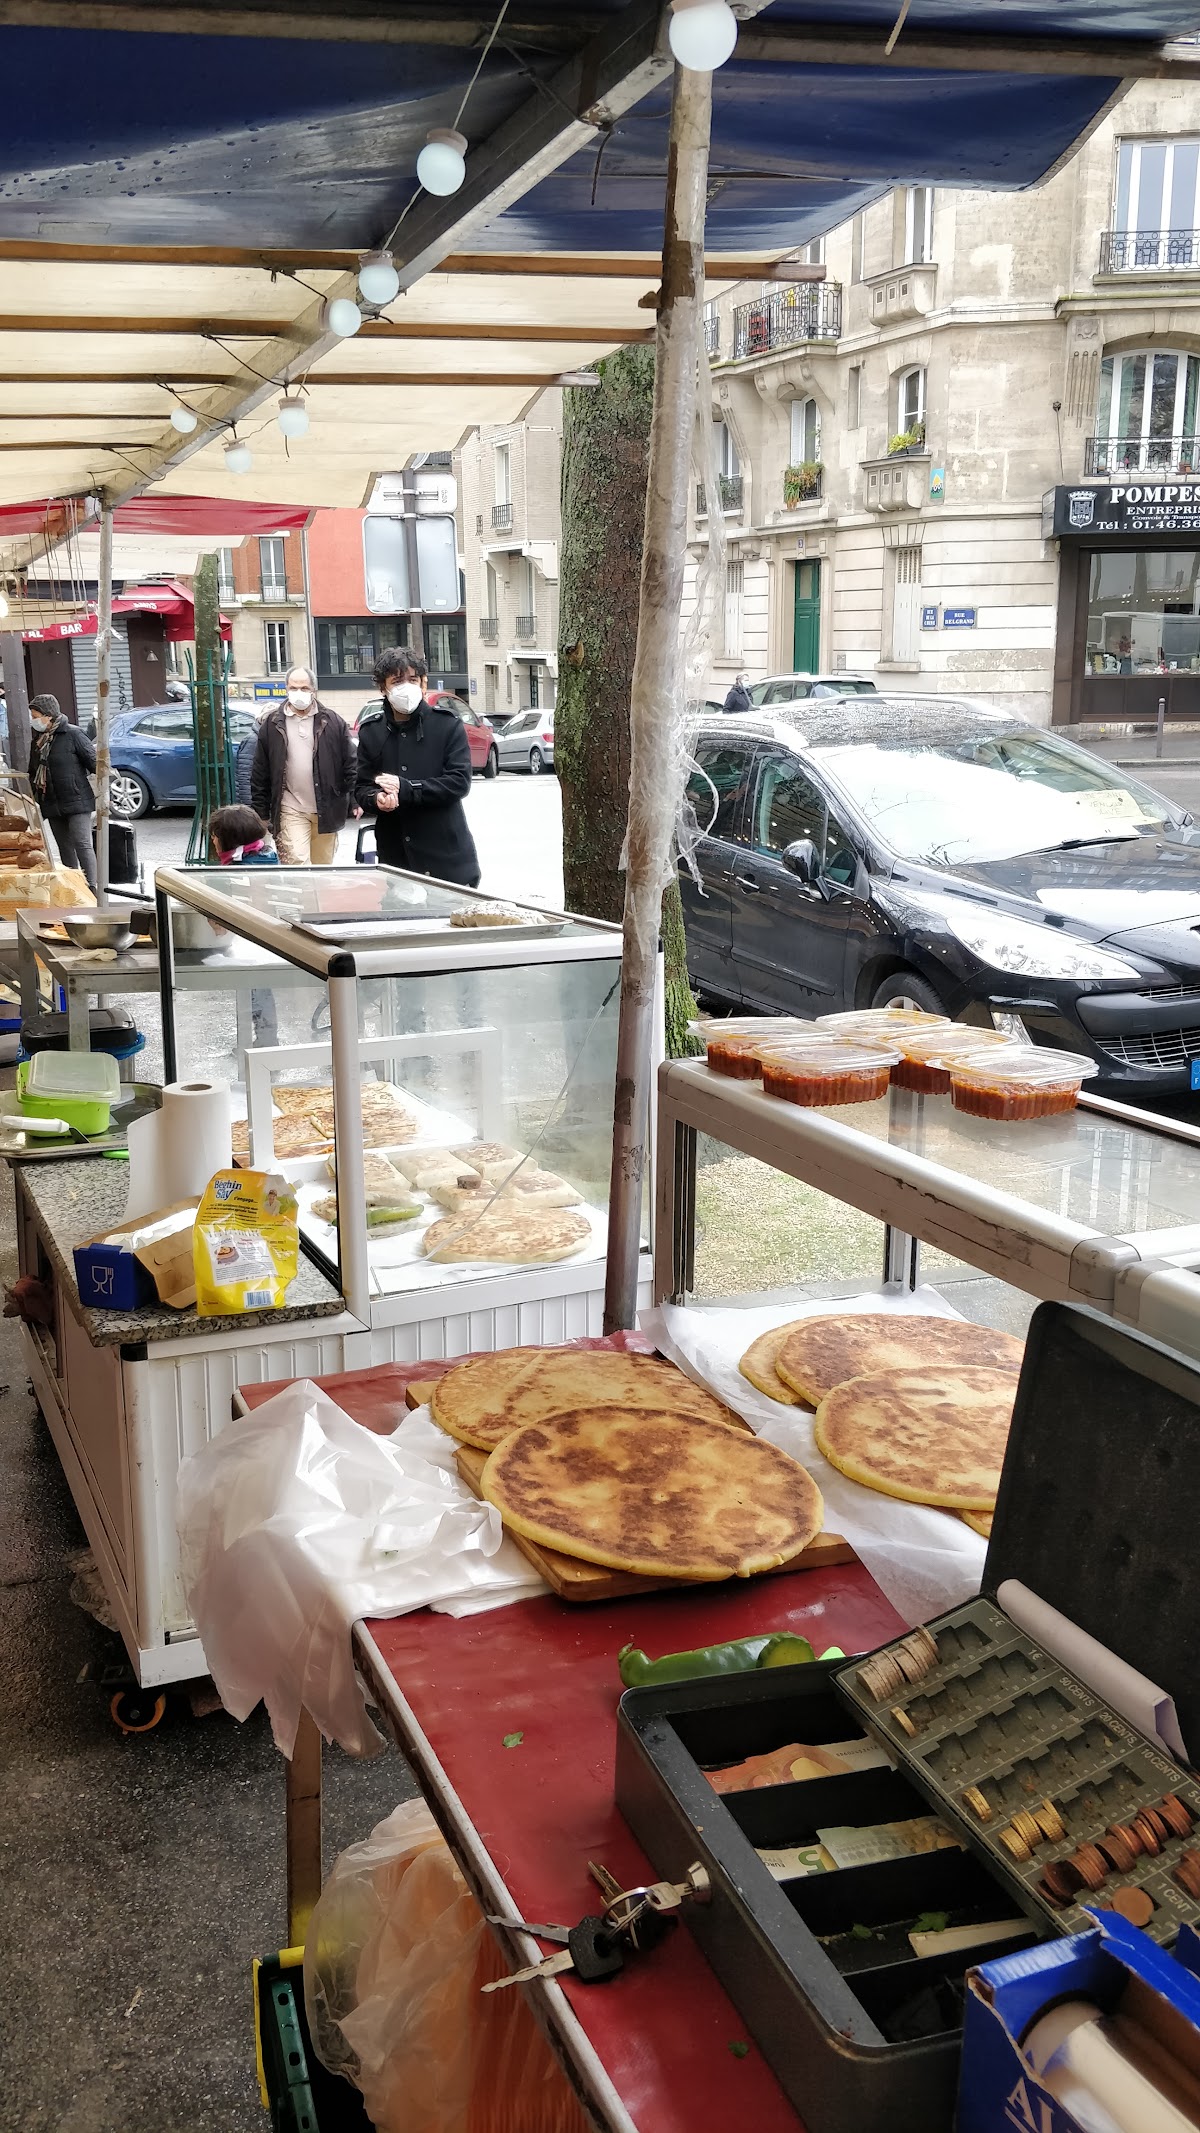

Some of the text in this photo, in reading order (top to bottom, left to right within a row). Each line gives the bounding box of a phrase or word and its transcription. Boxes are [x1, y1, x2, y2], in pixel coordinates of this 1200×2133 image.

[1126, 505, 1200, 516] ENTREPRI
[1096, 521, 1119, 530] Tél
[60, 623, 83, 636] BAR
[1194, 1077, 1200, 1085] F
[988, 1615, 1006, 1628] 2€
[1028, 1649, 1043, 1661] 1€
[1059, 1676, 1095, 1707] 50 CENTS
[1099, 1711, 1113, 1723] 20
[1109, 1719, 1138, 1745] CENTS
[1140, 1748, 1181, 1783] 10 CENTS
[1187, 1790, 1199, 1798] 5
[798, 1849, 828, 1876] 5
[1157, 1882, 1193, 1913] 1 CENT
